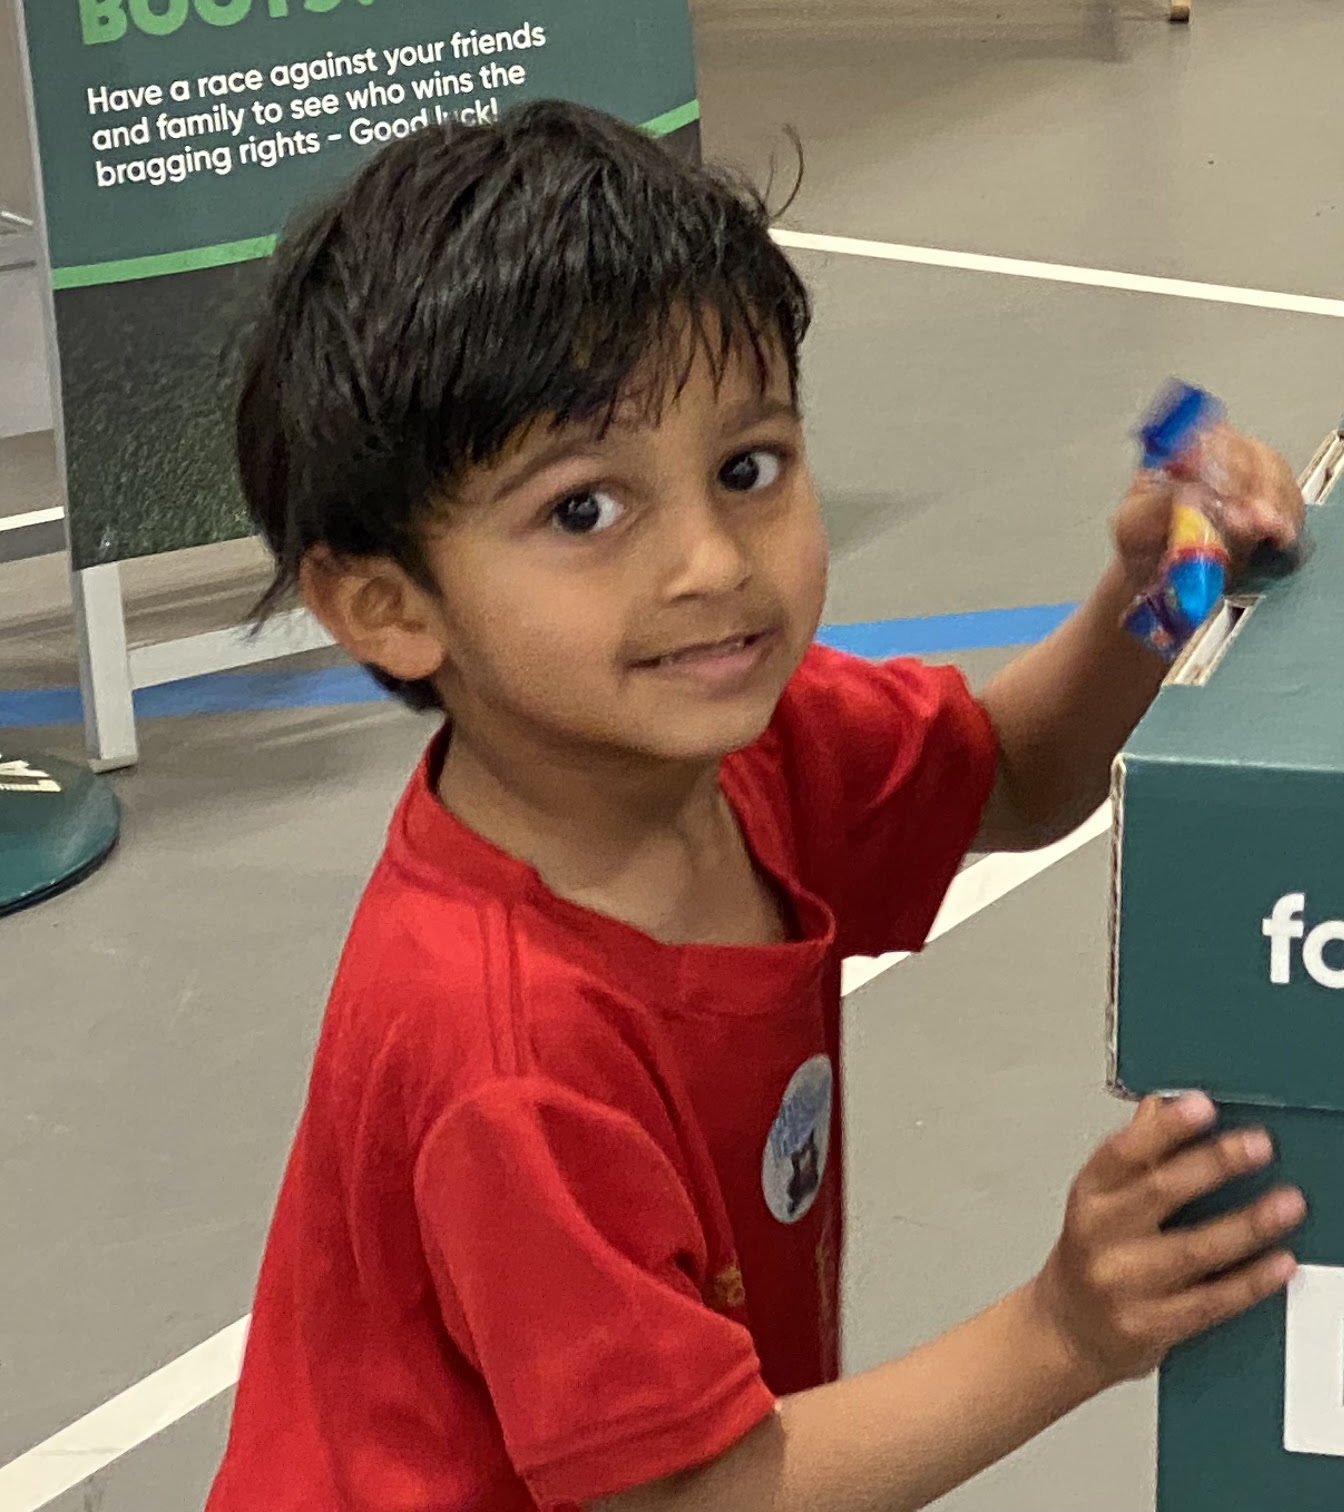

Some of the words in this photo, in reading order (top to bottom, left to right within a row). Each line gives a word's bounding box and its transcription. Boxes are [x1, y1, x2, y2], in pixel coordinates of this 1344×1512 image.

[86, 85, 164, 115] Have
[169, 79, 191, 102] a
[197, 68, 264, 98] race
[269, 48, 379, 91] against
[383, 39, 446, 76] your
[450, 21, 547, 60] friends
[91, 116, 151, 152] and
[156, 102, 246, 141] family
[251, 100, 284, 126] to
[290, 92, 340, 120] see
[345, 80, 406, 111] who
[411, 69, 475, 101] wins
[478, 61, 527, 91] the
[95, 144, 232, 188] bragging
[238, 129, 321, 168] rights
[349, 106, 429, 146] Good
